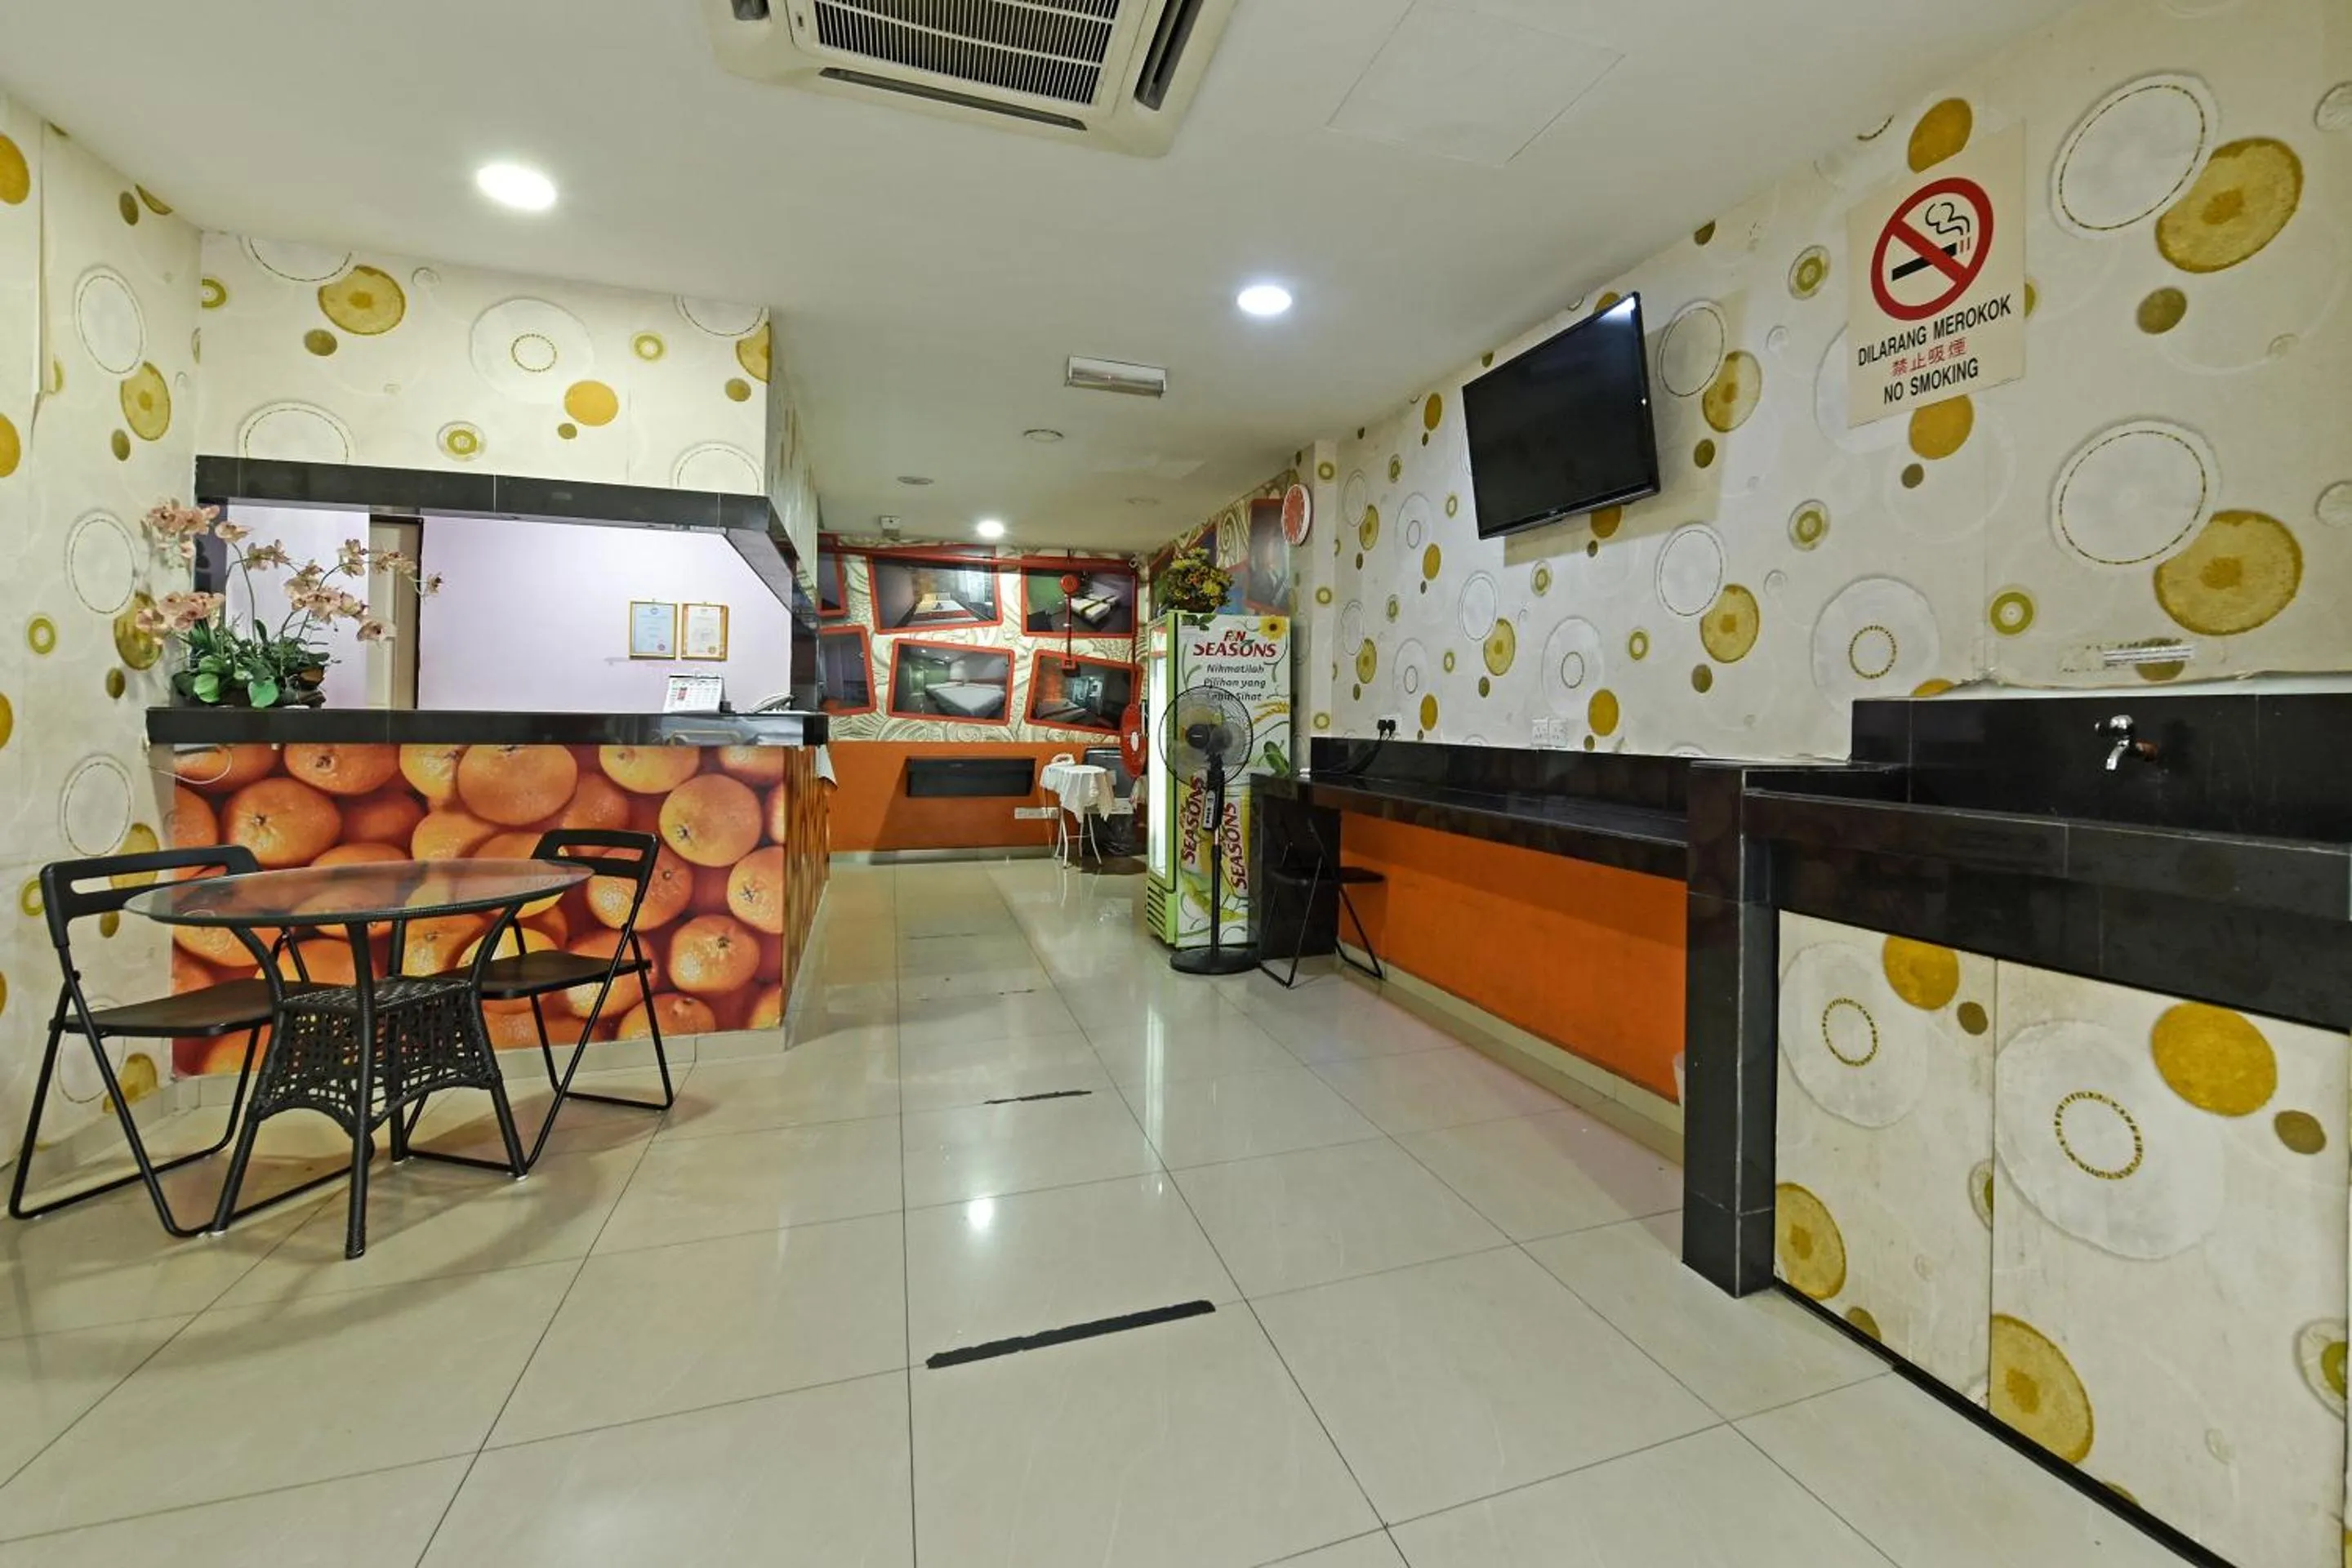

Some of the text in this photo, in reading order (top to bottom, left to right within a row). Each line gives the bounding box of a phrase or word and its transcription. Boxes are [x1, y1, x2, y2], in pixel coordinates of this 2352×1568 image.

[1858, 294, 2011, 366] DILARANG MEROKOK
[1884, 357, 1979, 404] NO SMOKING
[1193, 642, 1276, 657] SEASONS
[1206, 663, 1265, 674] Nikmatilah
[1241, 679, 1266, 689] yang
[1224, 802, 1247, 890] SEASONS
